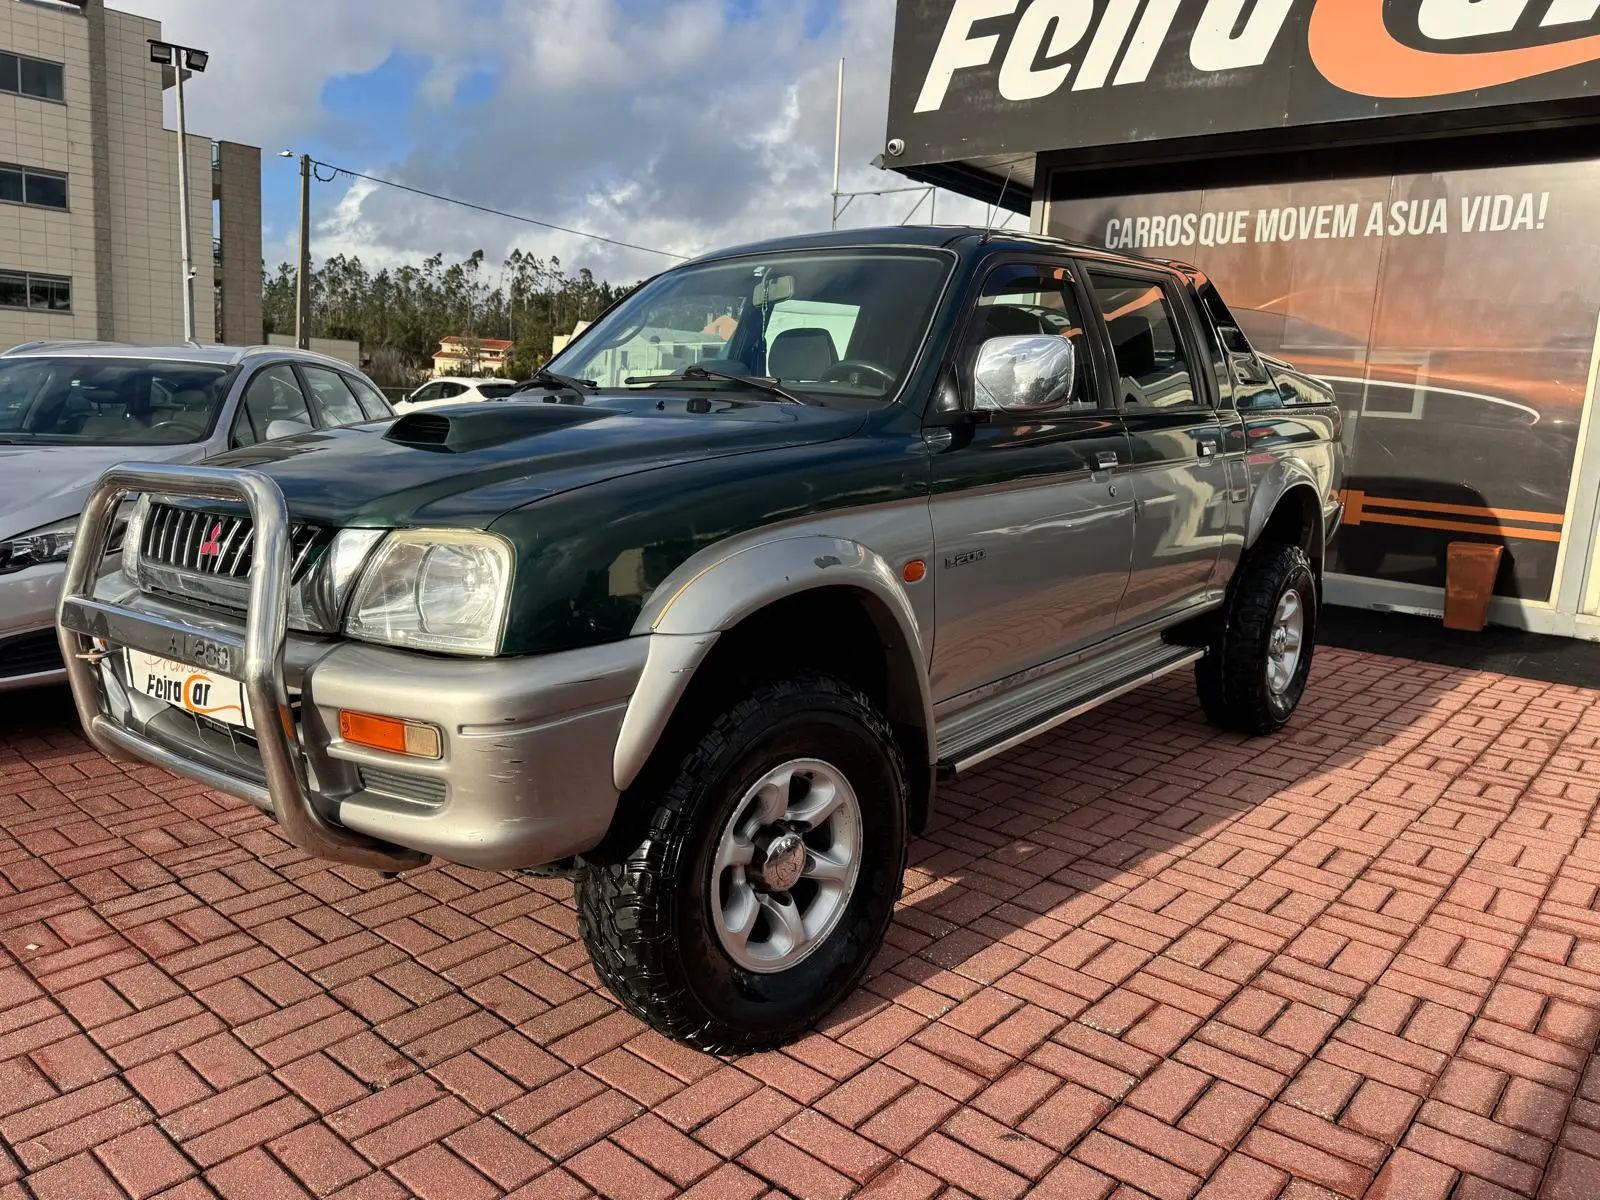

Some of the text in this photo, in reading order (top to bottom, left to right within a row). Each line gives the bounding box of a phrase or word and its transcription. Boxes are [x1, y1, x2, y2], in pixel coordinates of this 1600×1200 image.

[1105, 192, 1549, 249] CARROS QUE MOVEM A SUA VIDA!
